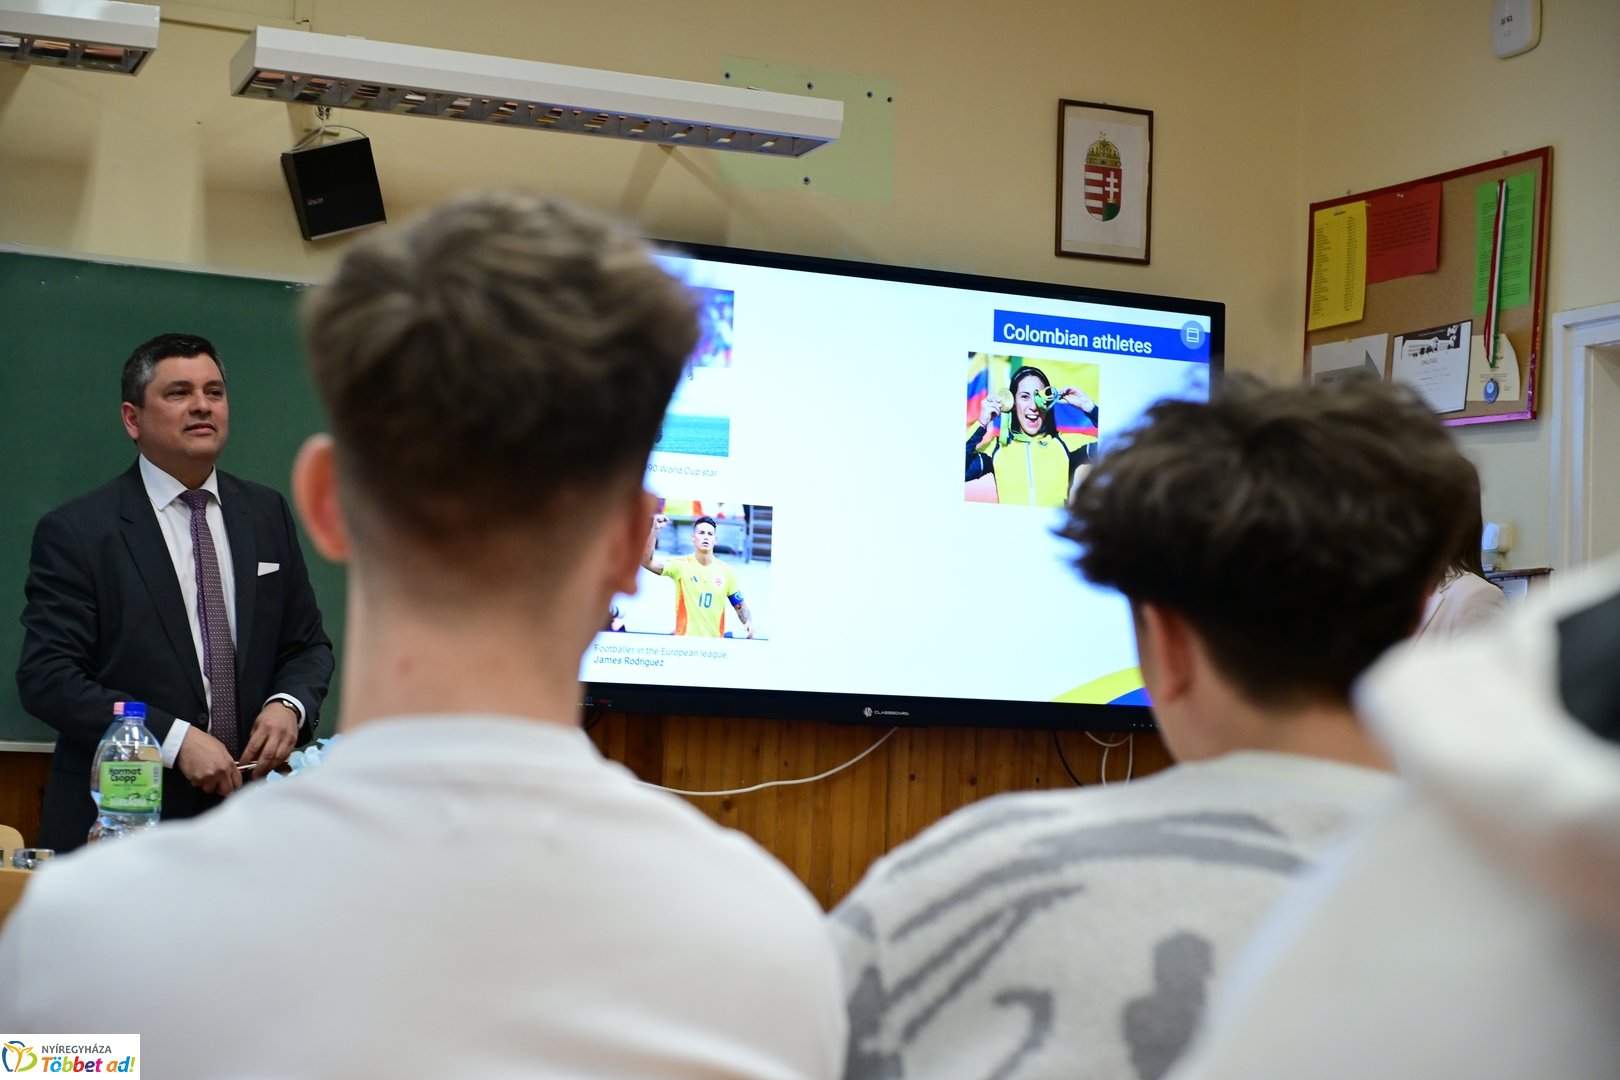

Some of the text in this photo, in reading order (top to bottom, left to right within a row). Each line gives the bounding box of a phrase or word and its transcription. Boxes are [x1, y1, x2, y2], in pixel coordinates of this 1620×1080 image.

[1003, 323, 1153, 354] Colombian athletes
[660, 465, 683, 475] World
[684, 467, 701, 478] Cup
[702, 468, 718, 477] star
[698, 592, 713, 609] 10
[594, 643, 635, 655] Footballer
[636, 647, 644, 655] in
[645, 647, 659, 656] the
[661, 648, 699, 659] European
[593, 655, 622, 665] James
